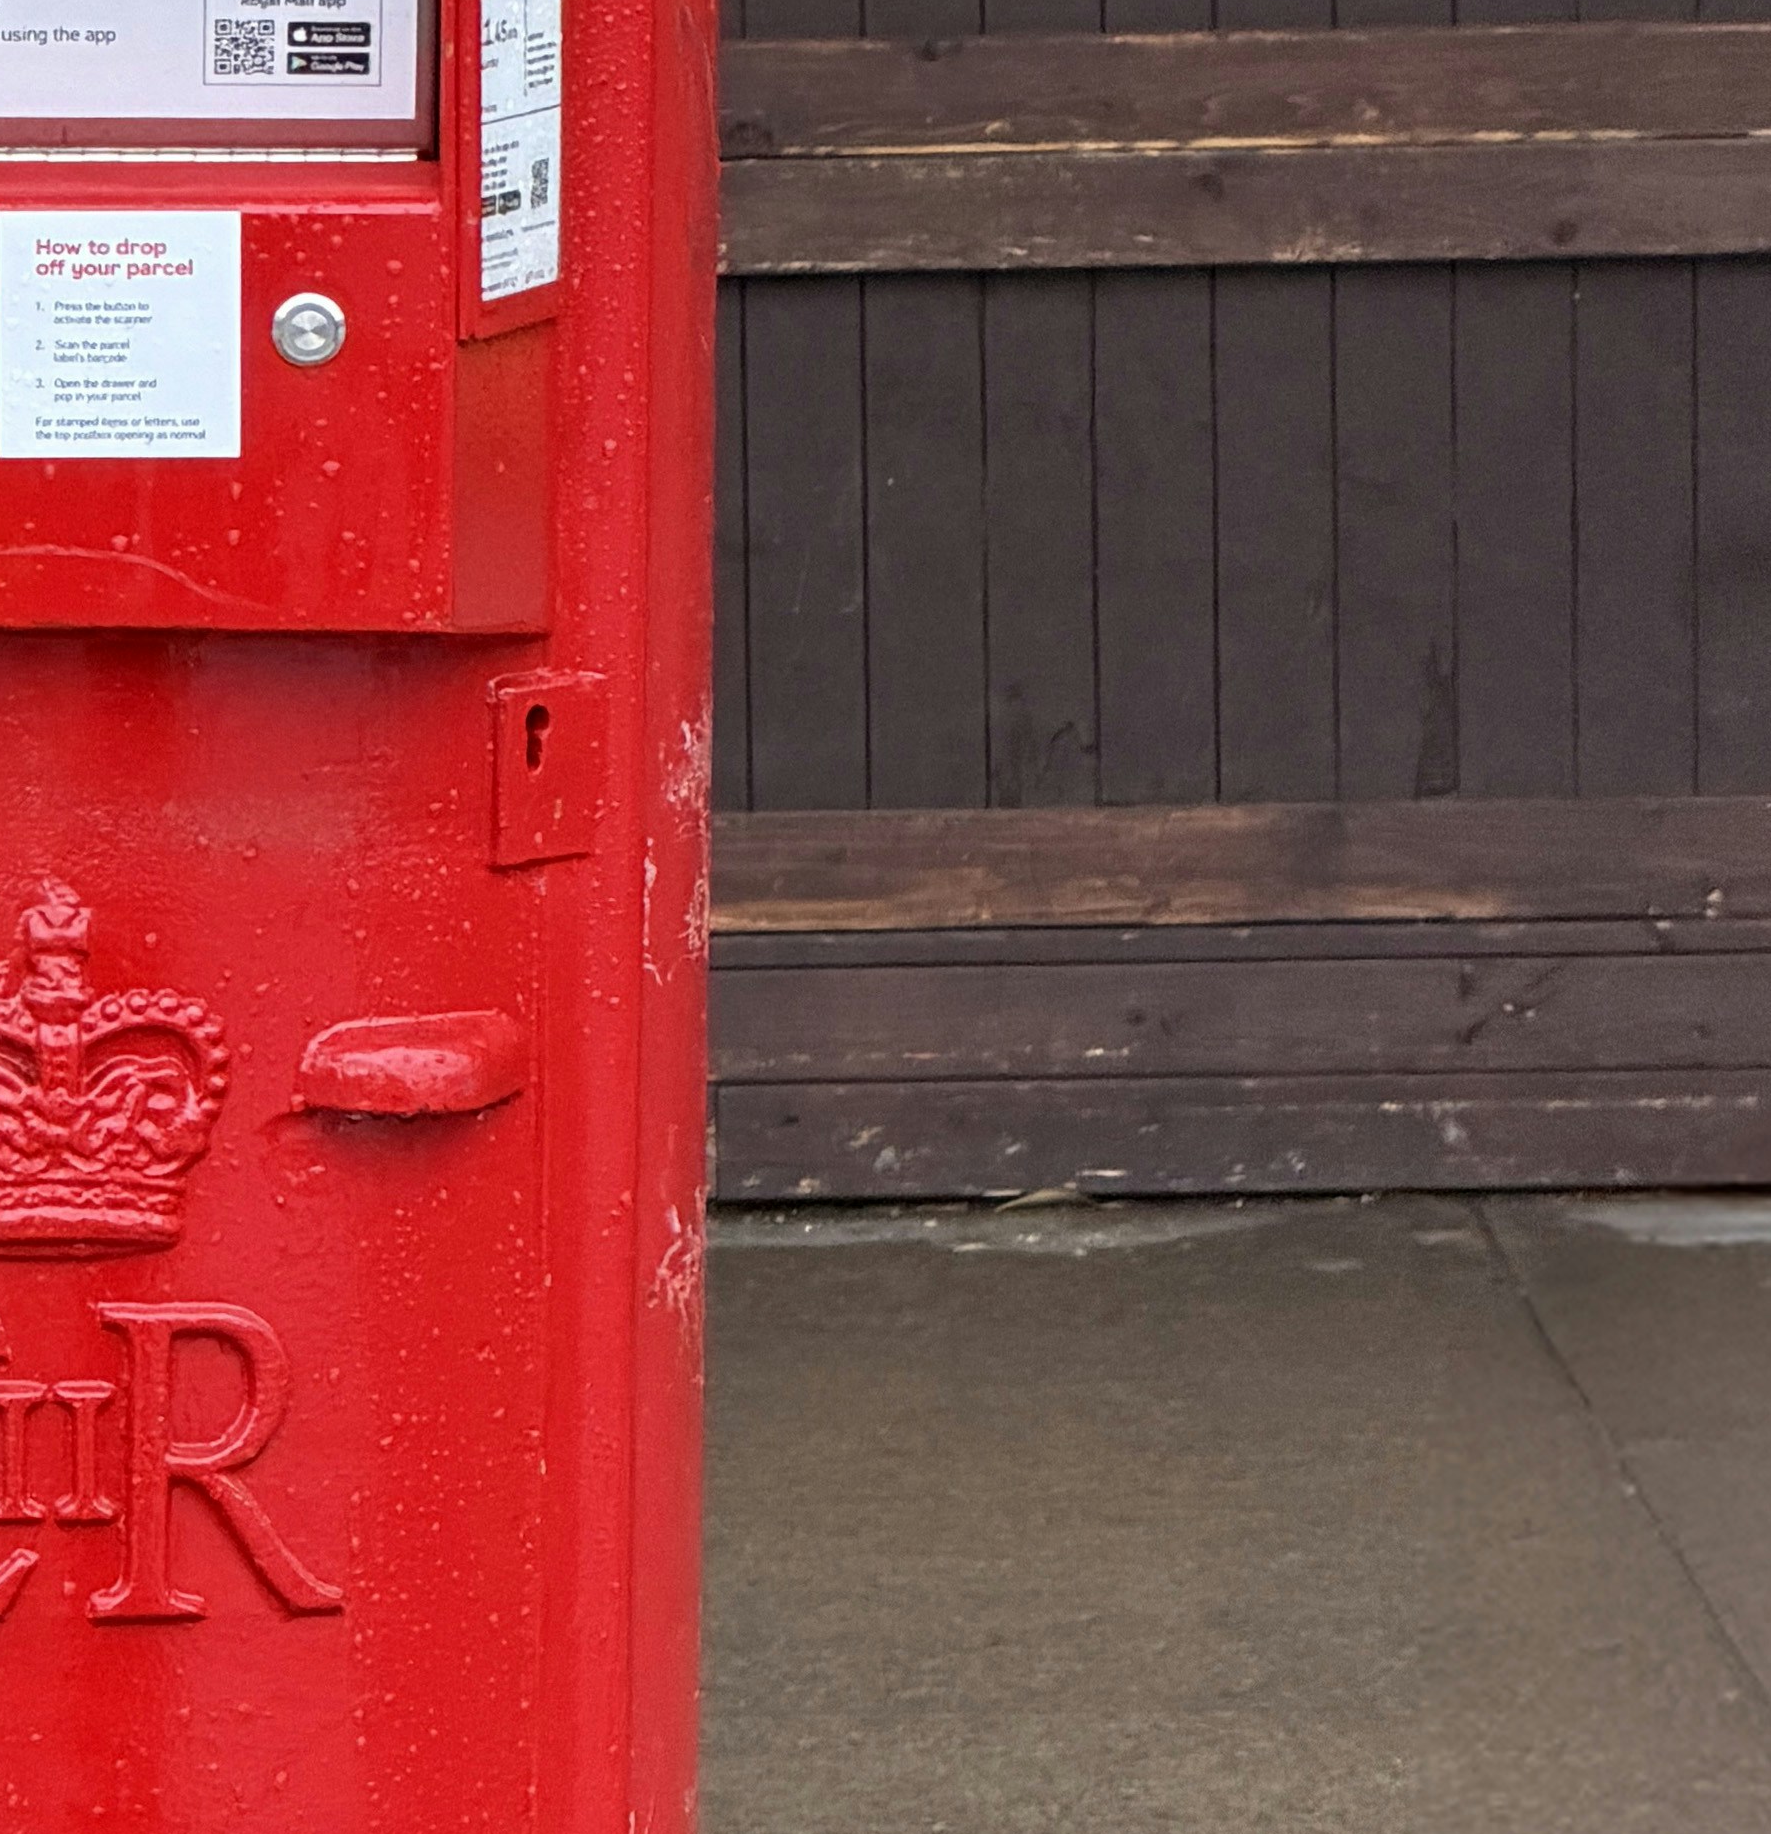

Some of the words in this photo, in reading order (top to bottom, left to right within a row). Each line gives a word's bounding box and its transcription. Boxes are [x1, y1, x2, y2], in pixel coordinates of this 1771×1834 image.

[1, 26, 49, 46] using
[52, 25, 81, 43] the
[85, 28, 117, 46] app
[35, 237, 82, 257] How
[87, 239, 111, 257] to
[115, 237, 168, 259] drop
[35, 259, 66, 276] off
[71, 261, 121, 280] your
[126, 258, 194, 280] parcel
[54, 301, 83, 312] Press
[85, 301, 101, 312] the
[103, 301, 136, 312] button
[138, 302, 150, 312] to
[53, 314, 92, 325] activate
[94, 314, 111, 325] the
[113, 315, 153, 326] scanner
[54, 339, 80, 350] Scan
[82, 339, 98, 350] the
[100, 339, 130, 351] parcel
[87, 353, 128, 364] barcode
[54, 379, 81, 389] Open
[83, 378, 99, 389] the
[101, 379, 136, 389] drawer
[138, 378, 157, 389] and
[54, 392, 73, 403] pop
[75, 392, 84, 401] in
[86, 393, 108, 404] your
[111, 391, 142, 403] parcel
[35, 417, 53, 427] For
[55, 417, 99, 429] stamped
[131, 419, 142, 427] or
[181, 418, 200, 427] use
[35, 430, 52, 440] the
[114, 430, 154, 443] opening
[156, 431, 168, 440] as
[169, 430, 206, 440] normal
